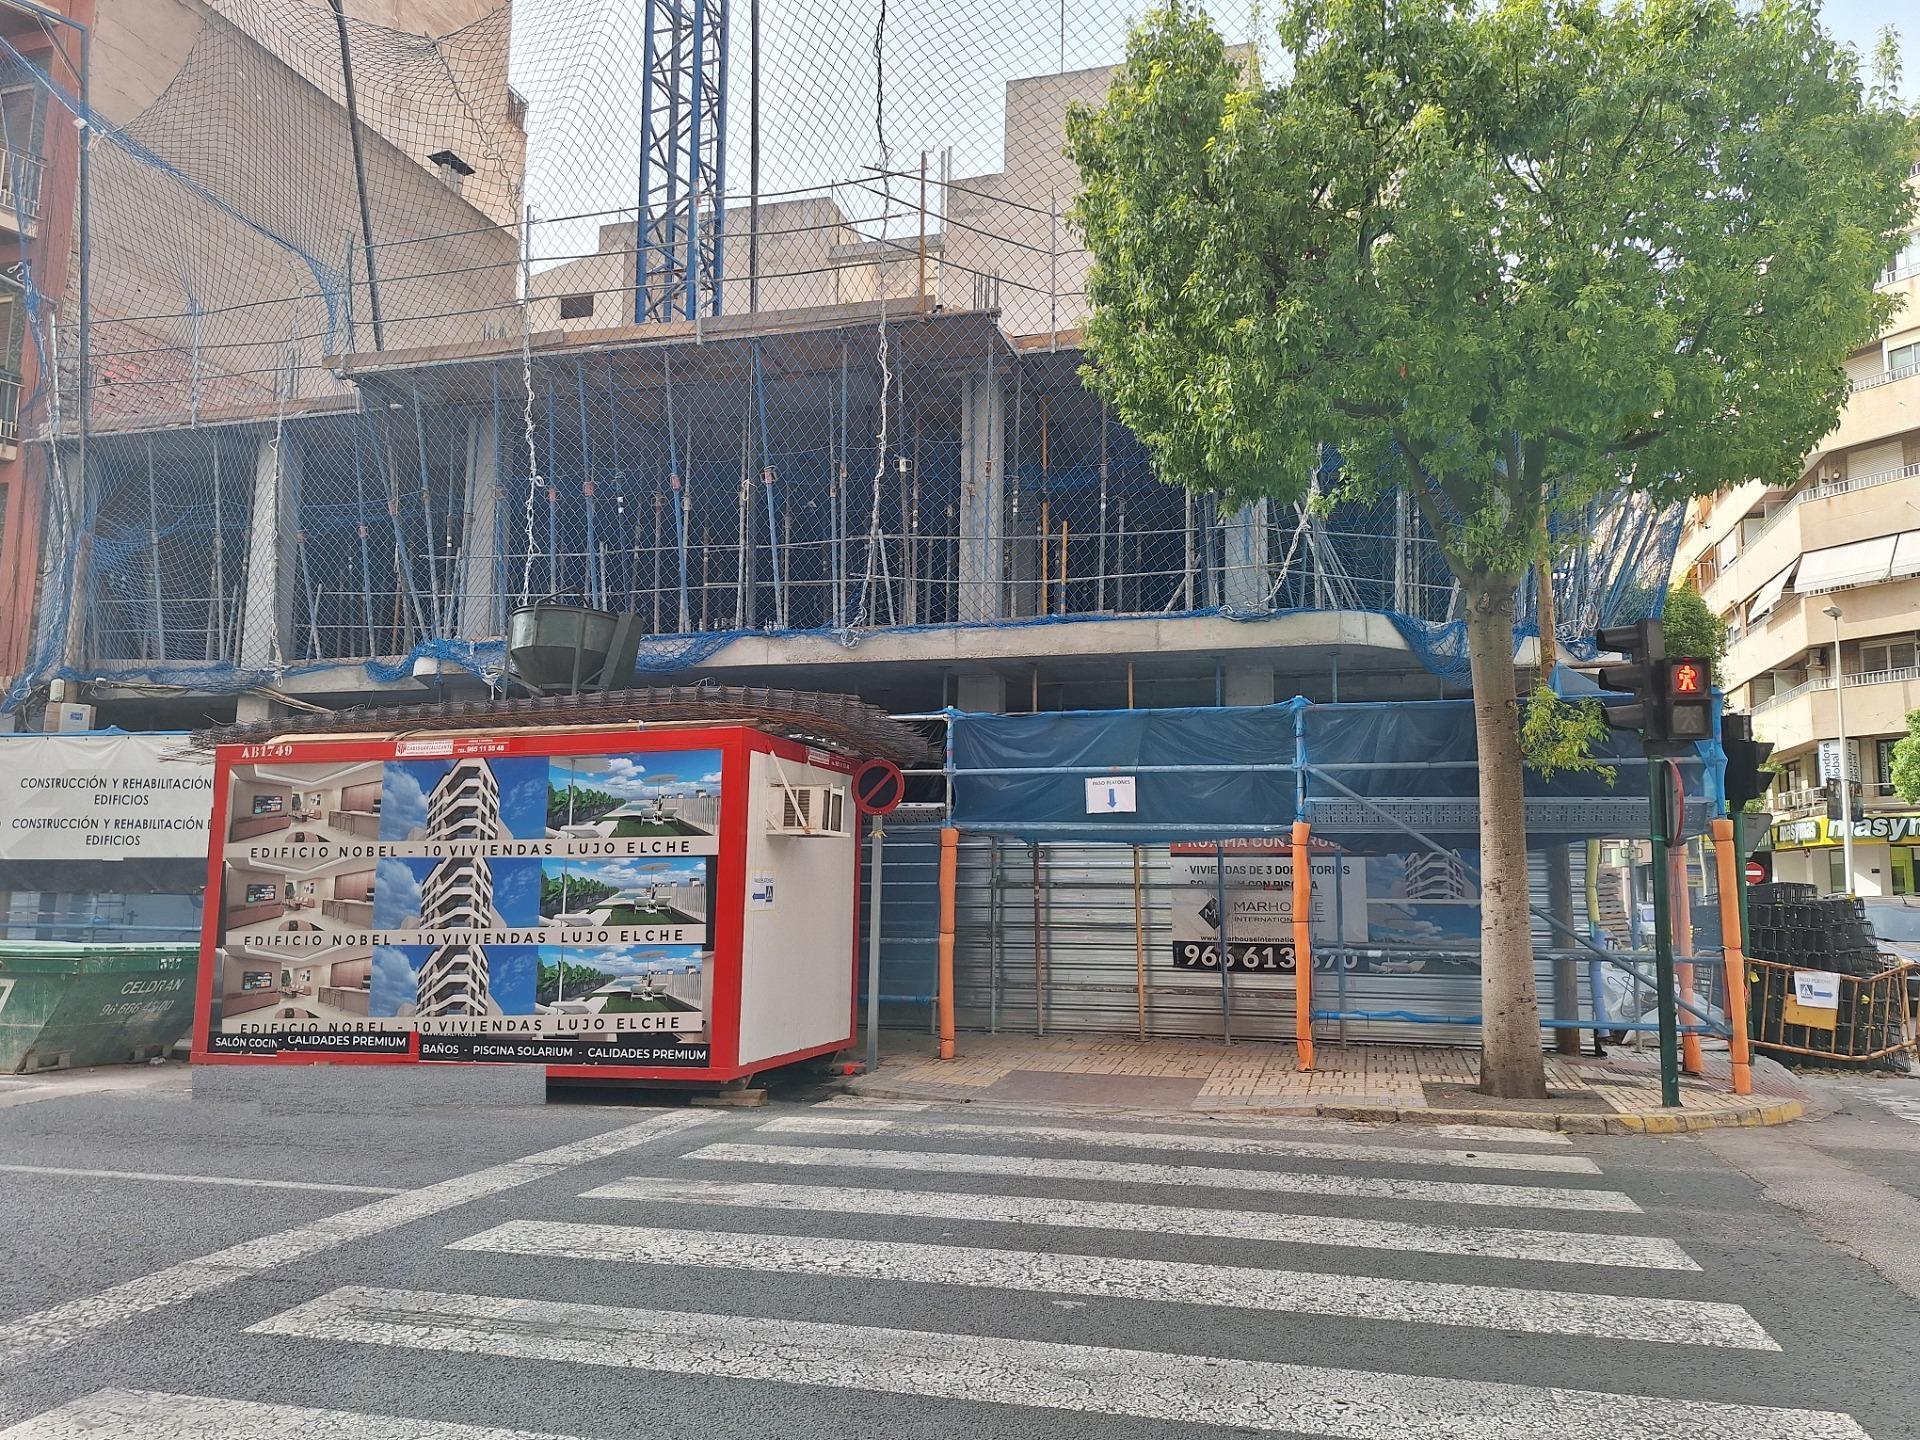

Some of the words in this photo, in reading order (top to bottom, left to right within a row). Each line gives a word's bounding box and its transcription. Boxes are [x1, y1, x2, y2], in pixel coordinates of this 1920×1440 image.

[242, 745, 293, 758] AB1749
[1822, 742, 1831, 778] andora
[20, 775, 107, 789] CONSTRUCCIÓN
[112, 777, 119, 789] Y
[122, 776, 212, 790] REHABILITACIÓN
[94, 794, 149, 806] EDIFICIOS
[12, 815, 99, 830] CONSTRUCCIÓN
[103, 818, 111, 829] Y
[114, 816, 204, 830] REHABILITACIÓN
[85, 835, 141, 846] EDIFICIOS
[250, 847, 329, 858] EDIFICIO
[339, 846, 398, 857] NOBEL
[423, 845, 442, 856] 10
[449, 843, 553, 857] VIVIENDAS
[567, 842, 616, 855] LUJO
[627, 840, 690, 854] ELCHE
[1190, 865, 1247, 875] VIVIEDAS
[1249, 865, 1264, 875] DE
[1265, 865, 1272, 875] 3
[1234, 901, 1325, 912] MARHOE
[244, 935, 322, 945] EDIFICIO
[332, 934, 391, 945] NOBEL
[416, 933, 435, 945] 10
[441, 932, 546, 945] VIVIENDAS
[561, 930, 609, 943] LUJO
[620, 929, 683, 942] ELCHE
[1242, 946, 1297, 969] 613
[121, 978, 185, 995] CELDRAN
[240, 1023, 318, 1034] EDIFICIO
[329, 1022, 387, 1033] NOBEL
[413, 1021, 431, 1032] 10
[439, 1020, 542, 1032] VIVIENDAS
[557, 1018, 605, 1031] LUJO
[616, 1016, 680, 1029] ELCHE
[215, 1035, 246, 1047] SALÓN
[287, 1035, 350, 1046] CALIDADES
[352, 1036, 406, 1048] PREMIUM
[422, 1042, 459, 1054] BAÑOS
[473, 1045, 517, 1055] PISCINA
[517, 1046, 573, 1057] SOLARIUM
[587, 1048, 650, 1059] CALIDADES
[652, 1049, 707, 1060] PREMIUM
